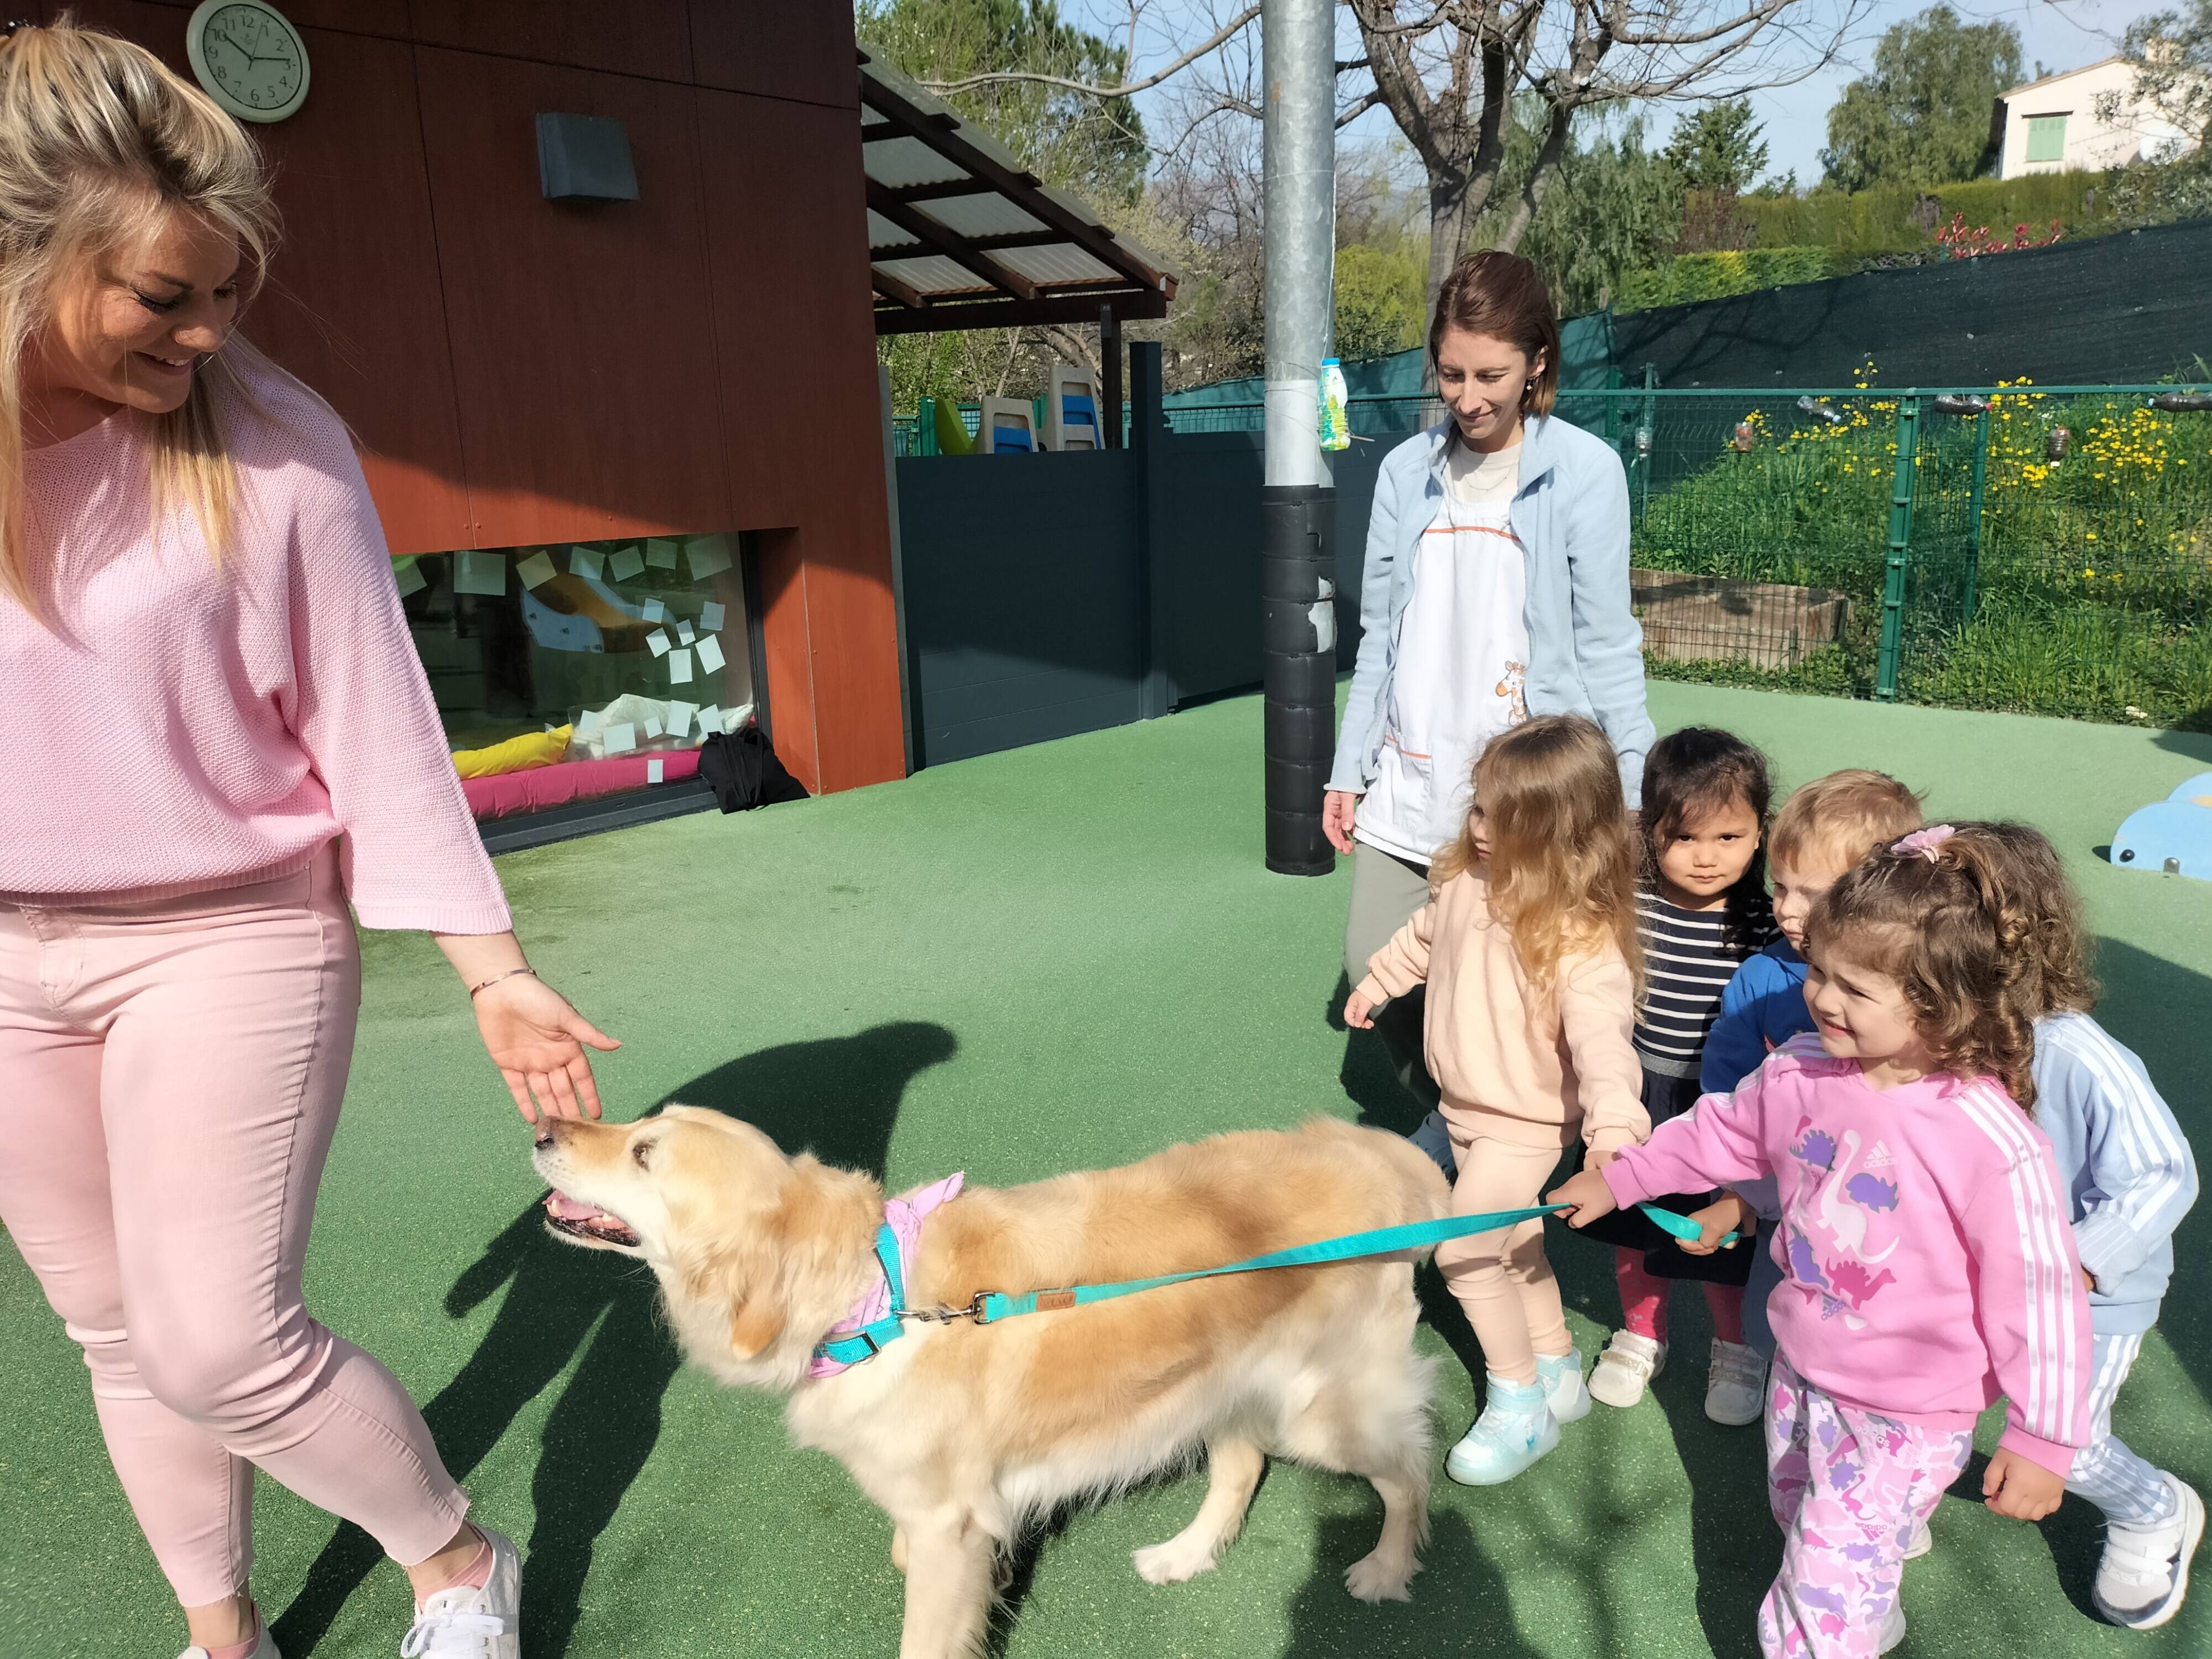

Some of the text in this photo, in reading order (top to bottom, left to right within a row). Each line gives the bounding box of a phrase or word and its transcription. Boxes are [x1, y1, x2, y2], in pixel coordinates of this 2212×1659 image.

[222, 18, 235, 31] 11
[239, 14, 254, 28] 12
[211, 28, 227, 42] 10
[262, 23, 269, 36] 1
[276, 39, 284, 51] 2
[208, 45, 218, 59] 9
[284, 59, 291, 70] 3
[217, 66, 227, 79] 8
[234, 81, 242, 92] 7
[279, 76, 287, 87] 4
[251, 89, 259, 102] 6
[268, 86, 275, 98] 5
[1863, 1157, 1898, 1168] adidas
